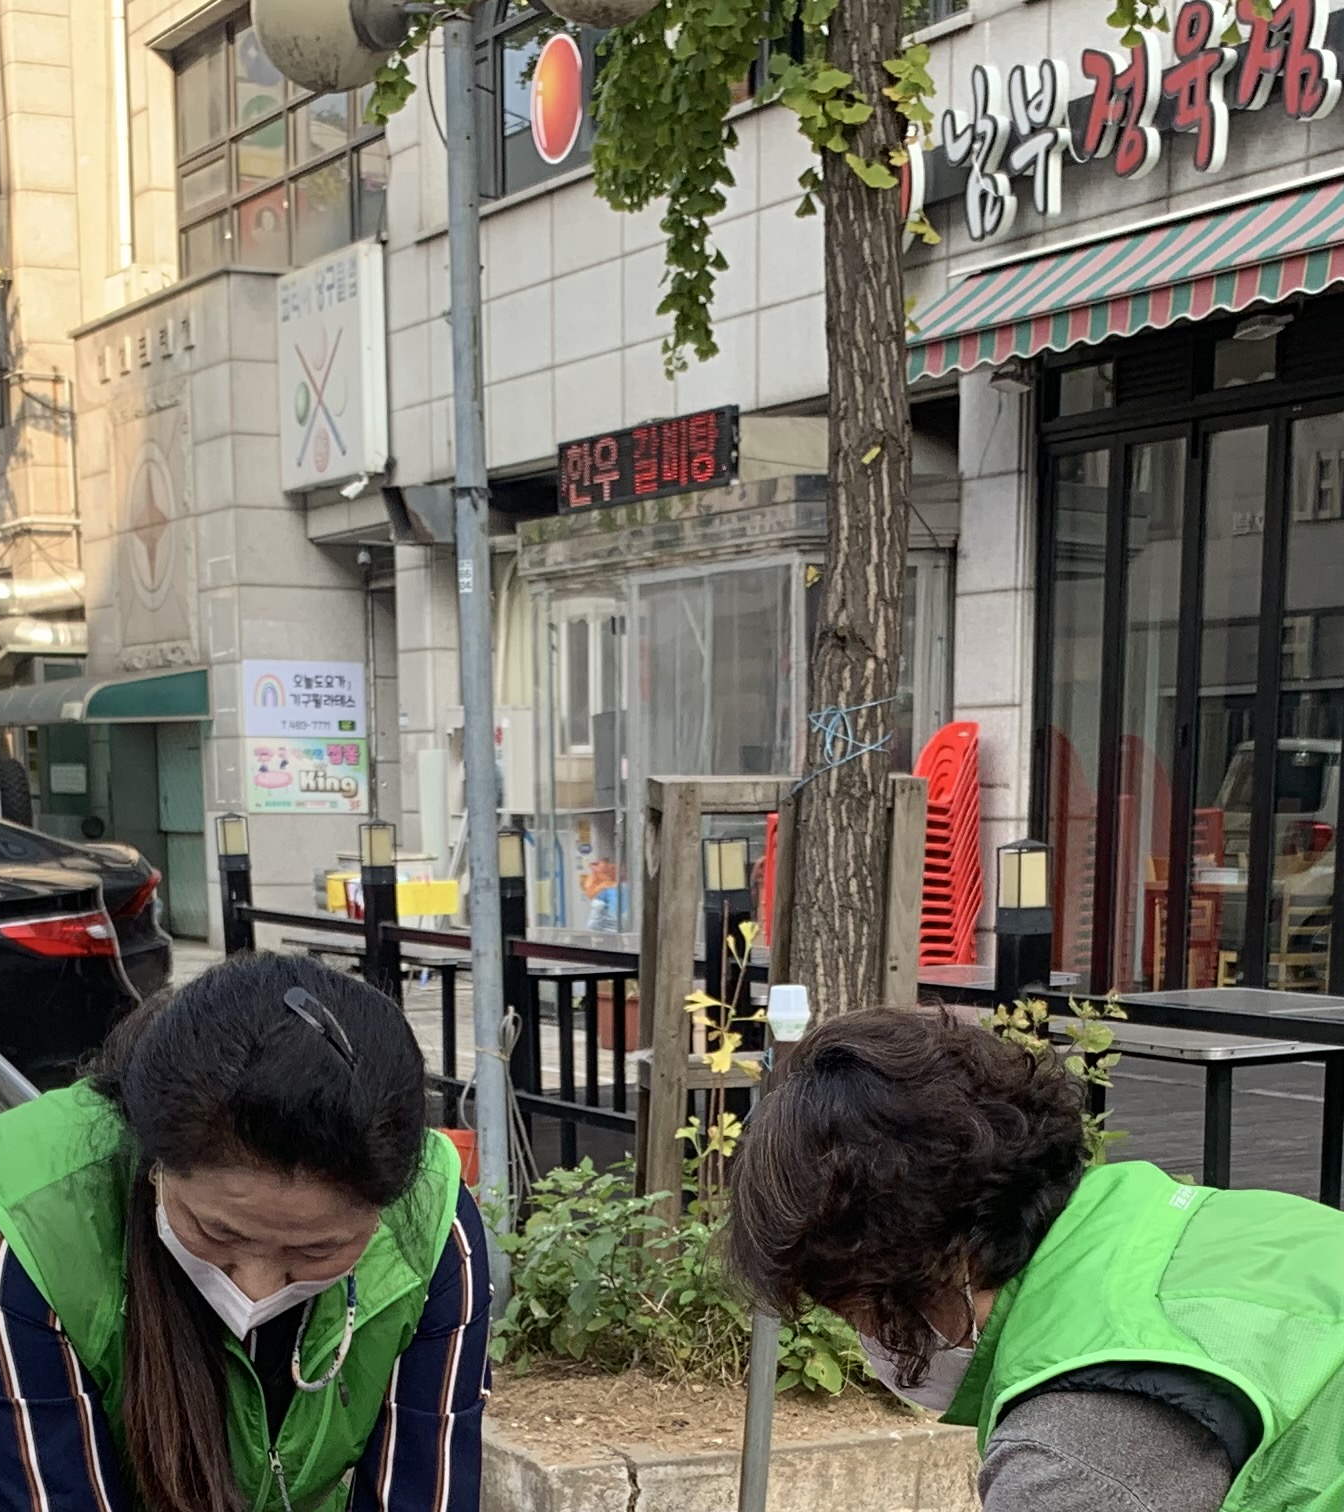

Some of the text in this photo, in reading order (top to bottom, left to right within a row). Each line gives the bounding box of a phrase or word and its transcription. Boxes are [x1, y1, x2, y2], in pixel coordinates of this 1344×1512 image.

[565, 411, 721, 508] 한우 갈비탕
[300, 769, 359, 799] King
